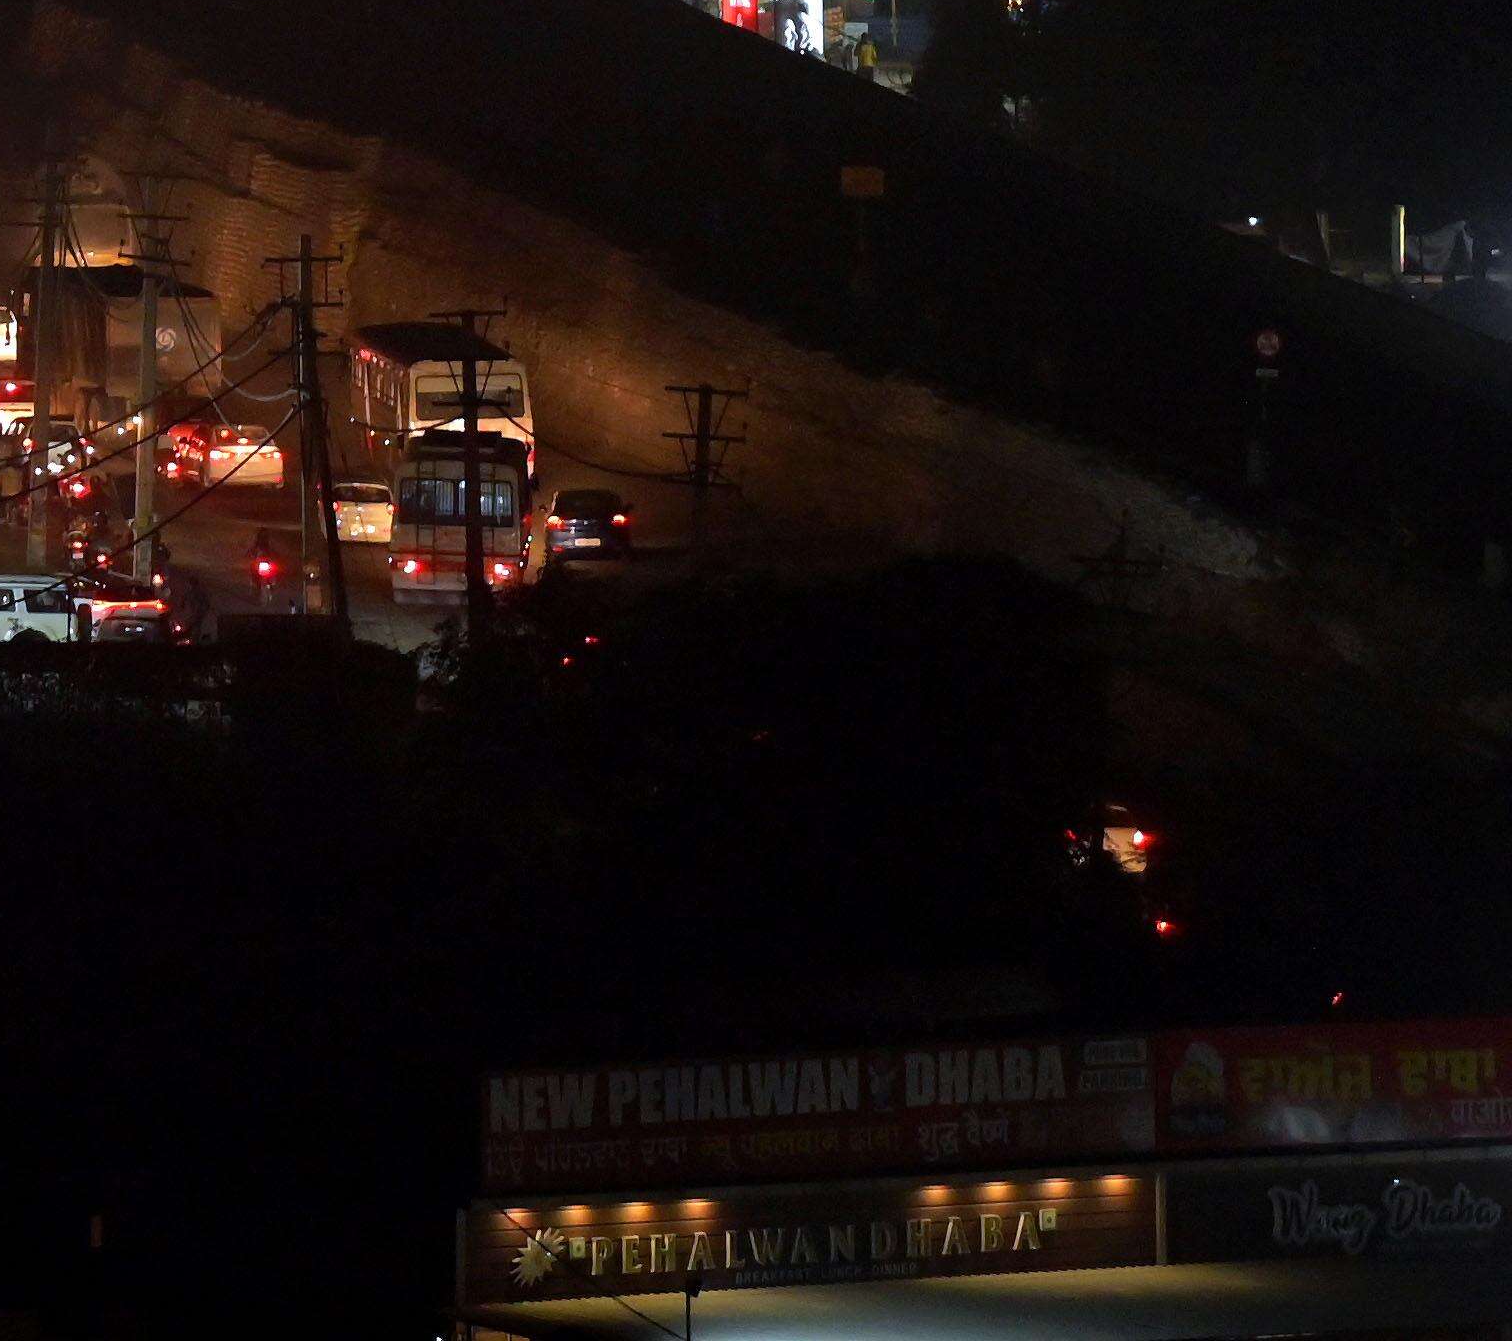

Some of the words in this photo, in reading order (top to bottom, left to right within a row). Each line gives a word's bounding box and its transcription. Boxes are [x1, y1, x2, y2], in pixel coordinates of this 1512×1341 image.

[488, 1070, 596, 1133] NEW
[607, 1057, 862, 1123] PEHALWAN
[903, 1045, 1067, 1106] DHABA
